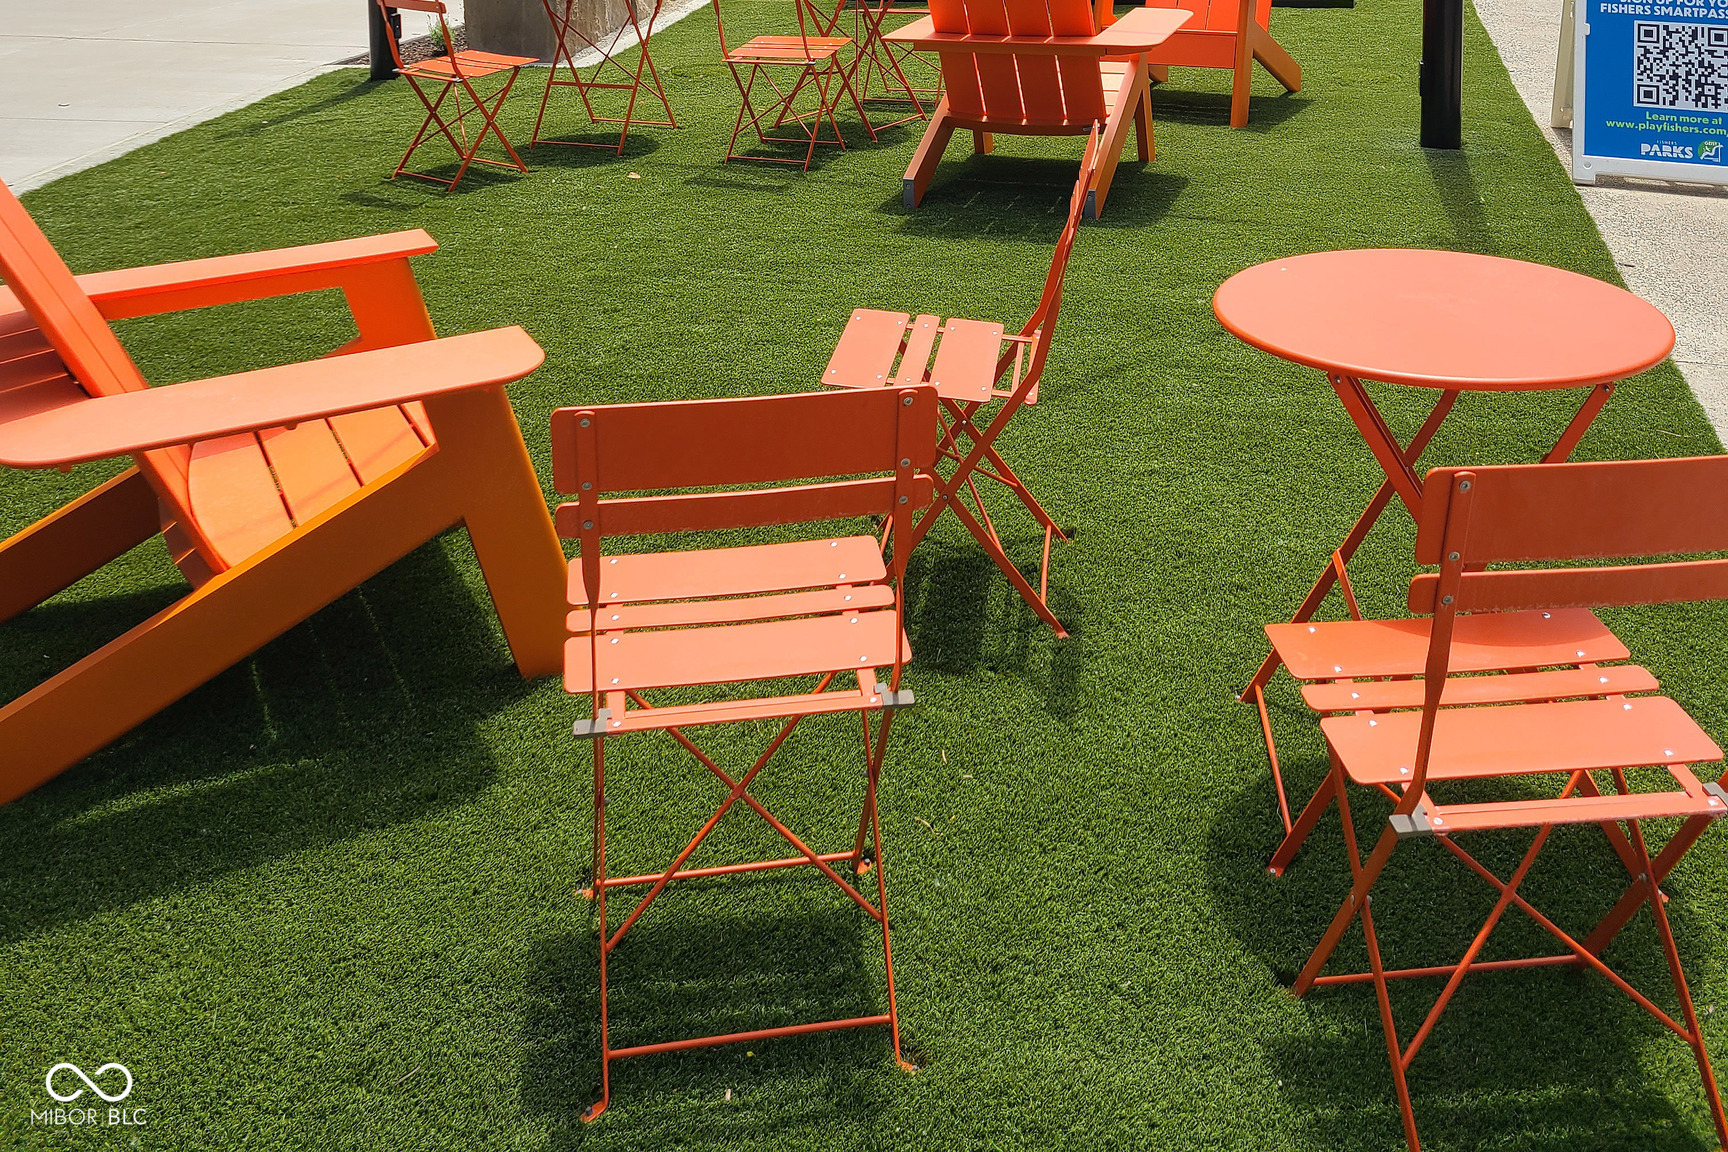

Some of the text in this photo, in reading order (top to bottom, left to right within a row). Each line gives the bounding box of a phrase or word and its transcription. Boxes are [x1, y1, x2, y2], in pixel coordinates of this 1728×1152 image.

[1600, 3, 1652, 15] FISHERS
[1645, 111, 1722, 125] Learn more at
[1640, 143, 1694, 159] PARKS
